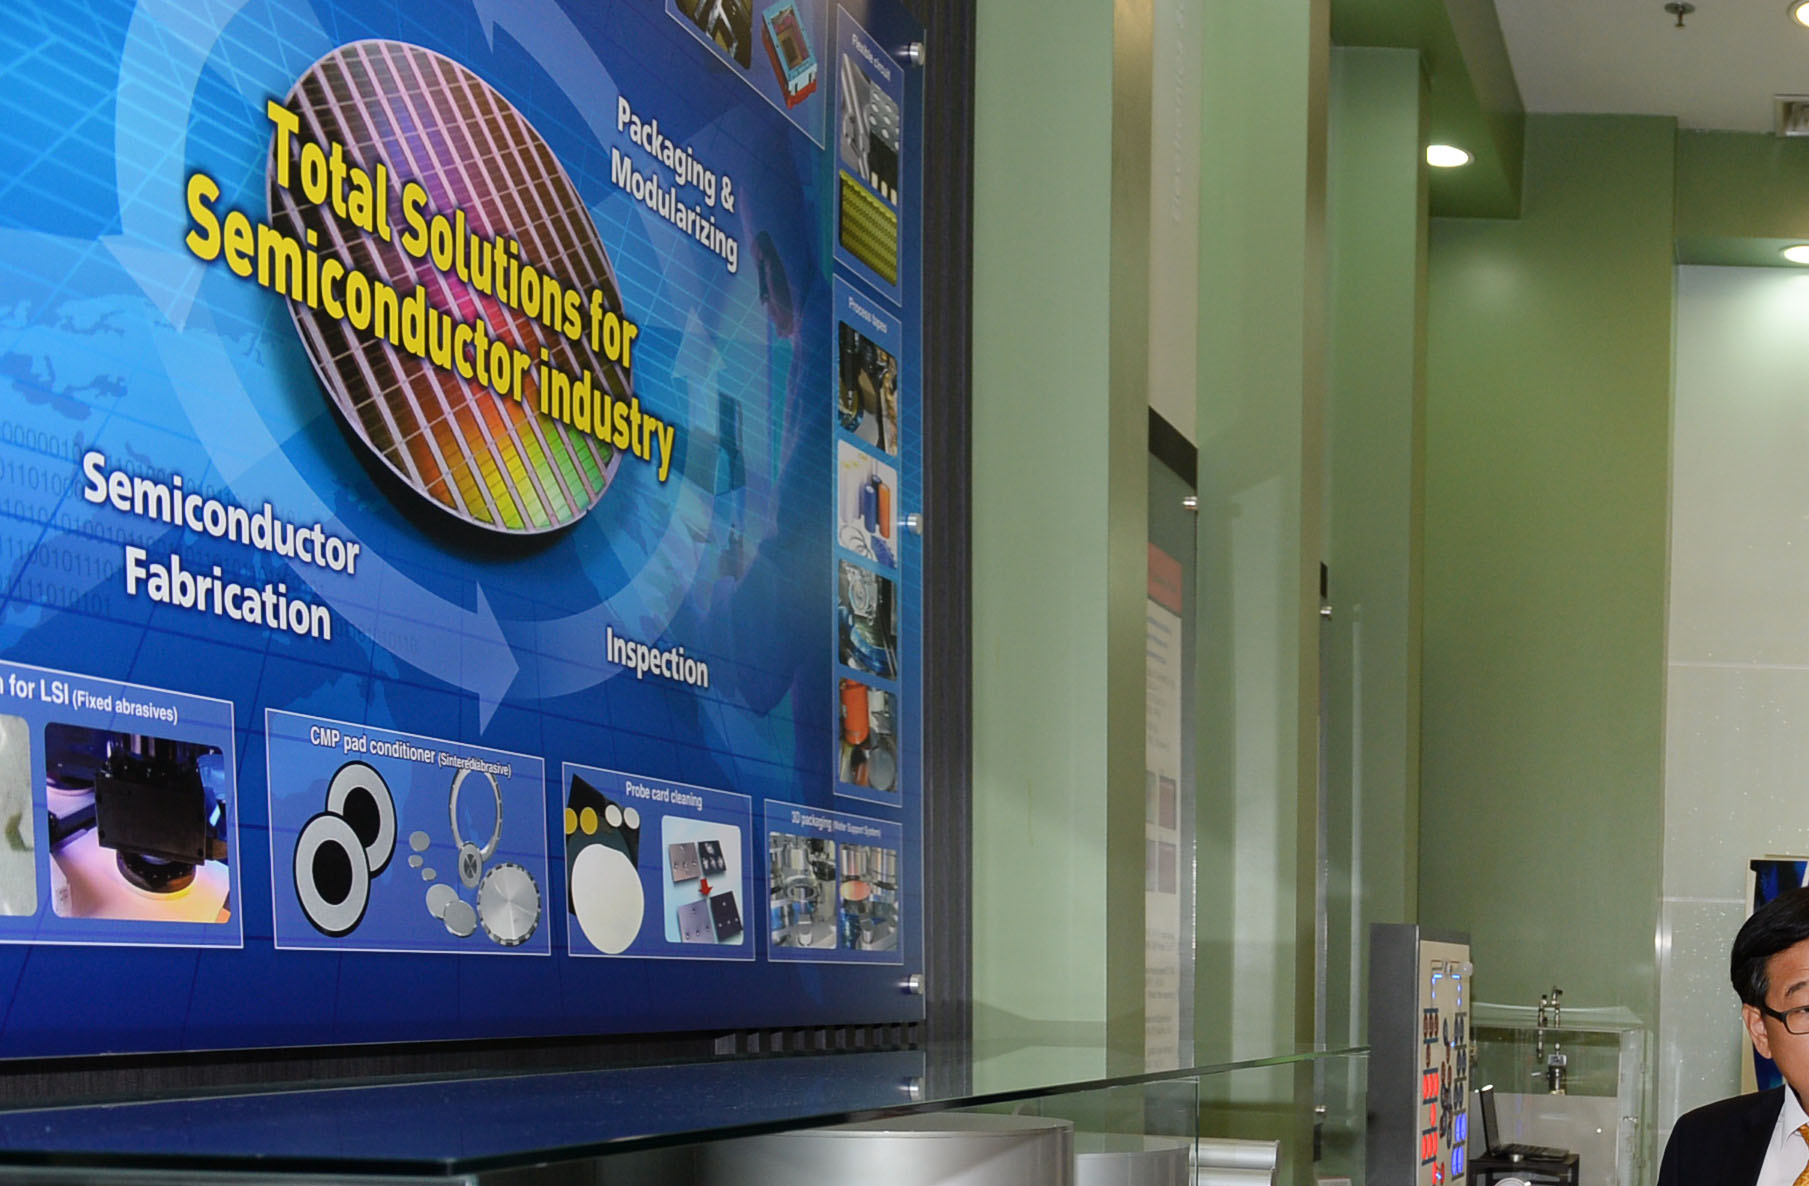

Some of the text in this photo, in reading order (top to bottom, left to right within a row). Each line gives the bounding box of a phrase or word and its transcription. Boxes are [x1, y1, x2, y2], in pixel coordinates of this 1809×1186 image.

[616, 95, 736, 213] Packaging &
[265, 98, 639, 368] Total Solutions for
[610, 148, 740, 274] Modularizing
[184, 172, 675, 482] Semiconductor industry
[82, 451, 361, 576] Semiconductor
[124, 547, 332, 642] Fabrication
[9, 673, 35, 699] for
[40, 678, 69, 705] LSI
[72, 689, 112, 711] (Fixed
[115, 698, 178, 726] abrasives)
[606, 626, 710, 689] Inspection
[310, 725, 340, 748] CMP
[343, 734, 366, 754] pad
[369, 738, 435, 764] conditioner
[626, 781, 703, 811] Probe card cleaning
